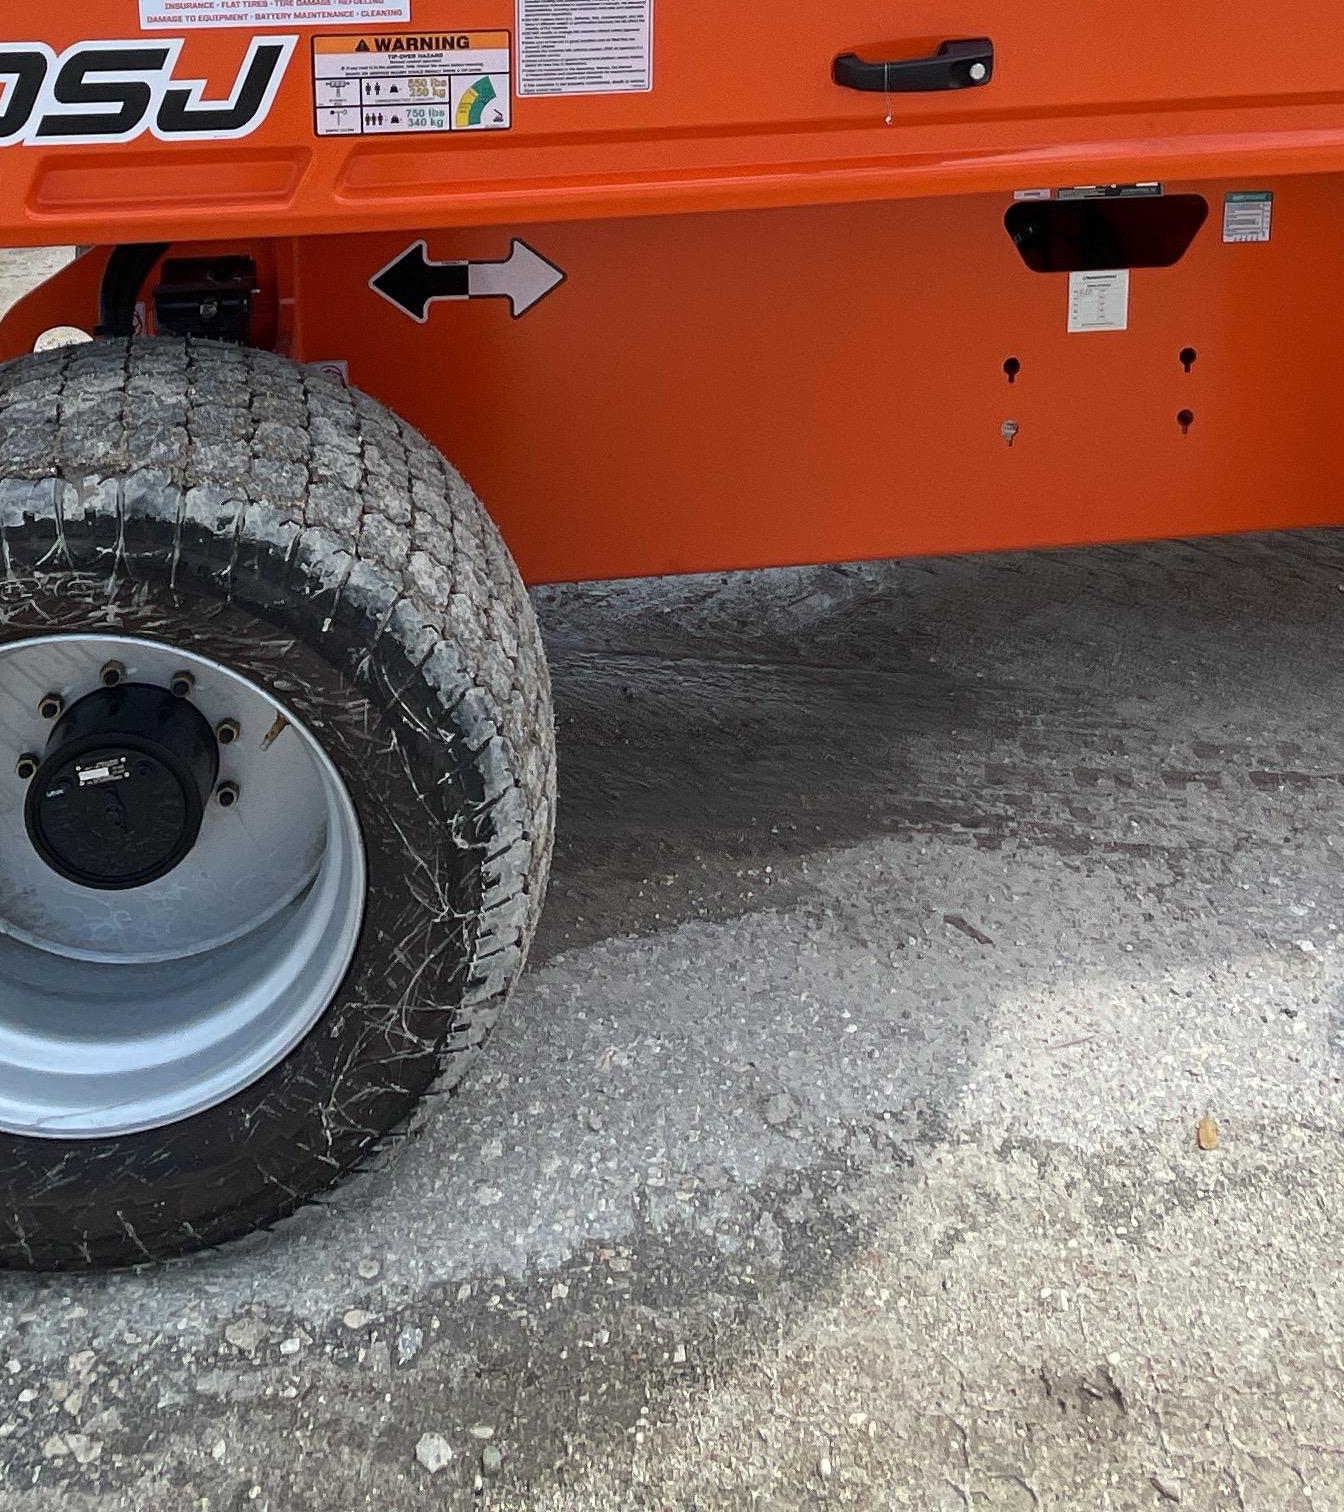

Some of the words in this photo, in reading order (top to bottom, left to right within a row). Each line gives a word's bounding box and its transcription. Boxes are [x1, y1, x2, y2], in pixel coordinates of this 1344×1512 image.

[164, 1, 214, 9] INSURANCE
[243, 0, 268, 8] TIRES
[274, 0, 294, 7] TIRE
[147, 15, 183, 23] DAMAGE
[198, 13, 248, 22] EQUIPMENT
[254, 12, 291, 20] BATTERY
[293, 10, 354, 19] MAINTENANCE
[360, 9, 402, 17] CLEANING
[375, 36, 470, 52] WARNING
[406, 108, 426, 118] 750
[428, 108, 445, 118] lbs
[407, 118, 427, 127] 340
[430, 118, 444, 127] kg
